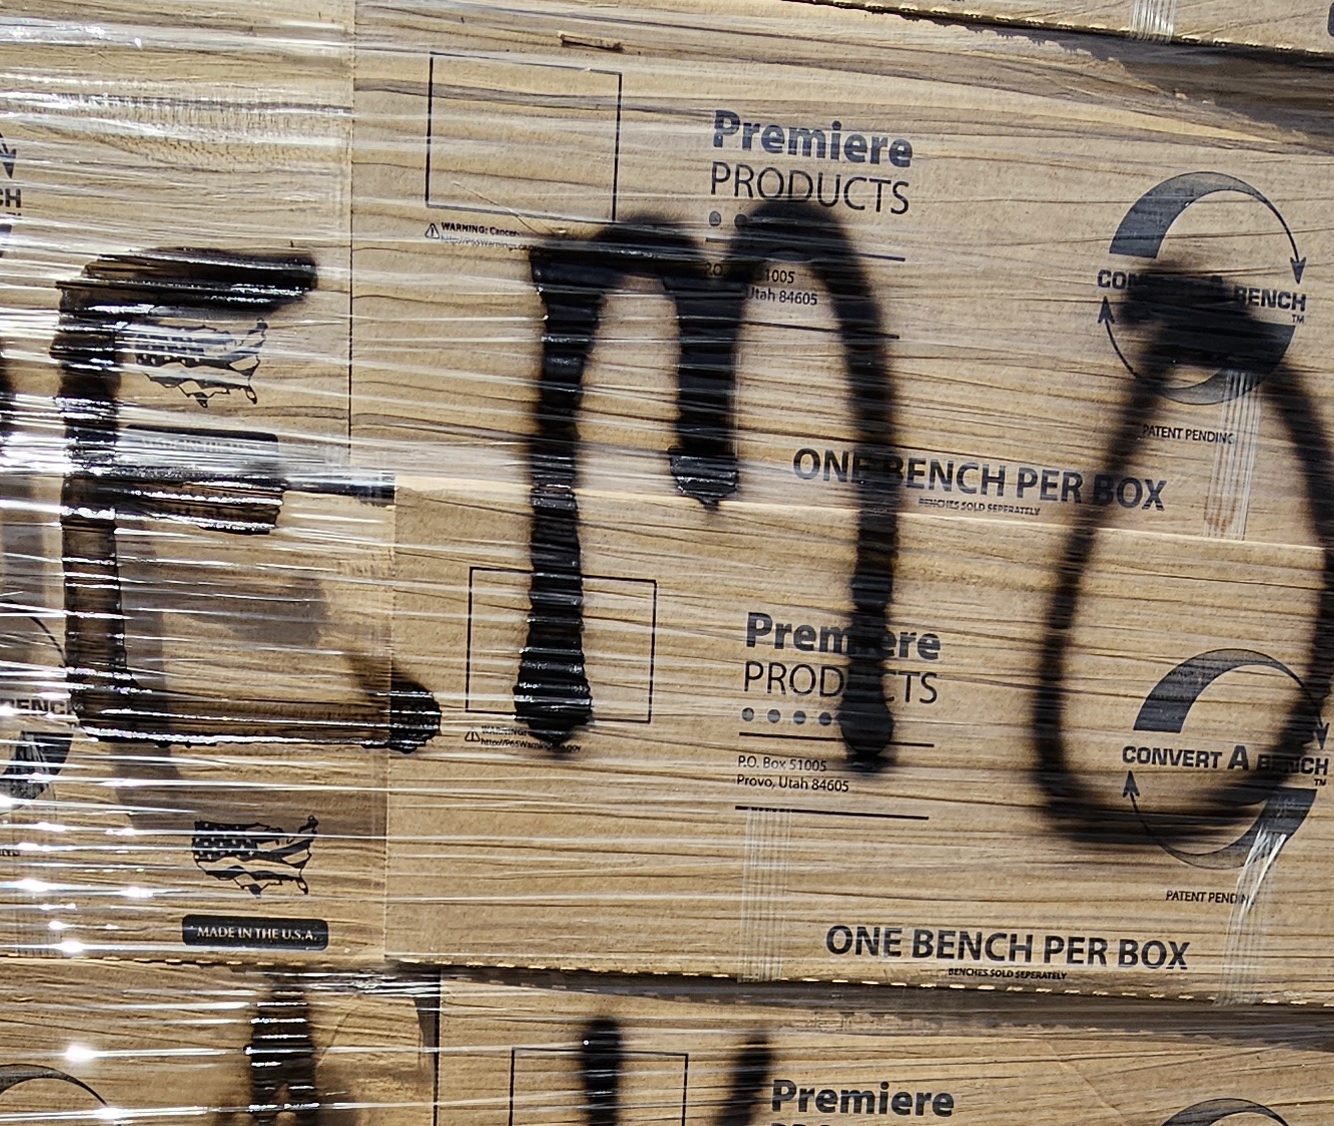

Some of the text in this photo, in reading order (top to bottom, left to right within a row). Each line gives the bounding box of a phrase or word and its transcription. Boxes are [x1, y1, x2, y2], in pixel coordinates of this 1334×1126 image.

[713, 109, 913, 168] Premiere
[711, 161, 910, 215] PRODUCTS
[793, 447, 865, 483] ONE
[1016, 466, 1082, 503] PER
[1094, 476, 1166, 512] BOX
[747, 612, 941, 660] Premere
[744, 661, 937, 704] PRODCTS
[1122, 744, 1250, 771] CONVERT A
[198, 925, 317, 941] MADE IN THE U.S.A.
[826, 925, 1190, 970] ONE BENCH PER BOX
[948, 967, 1067, 982] BENCHES SOLD SEPERATELY
[771, 1079, 955, 1117] Premiere
